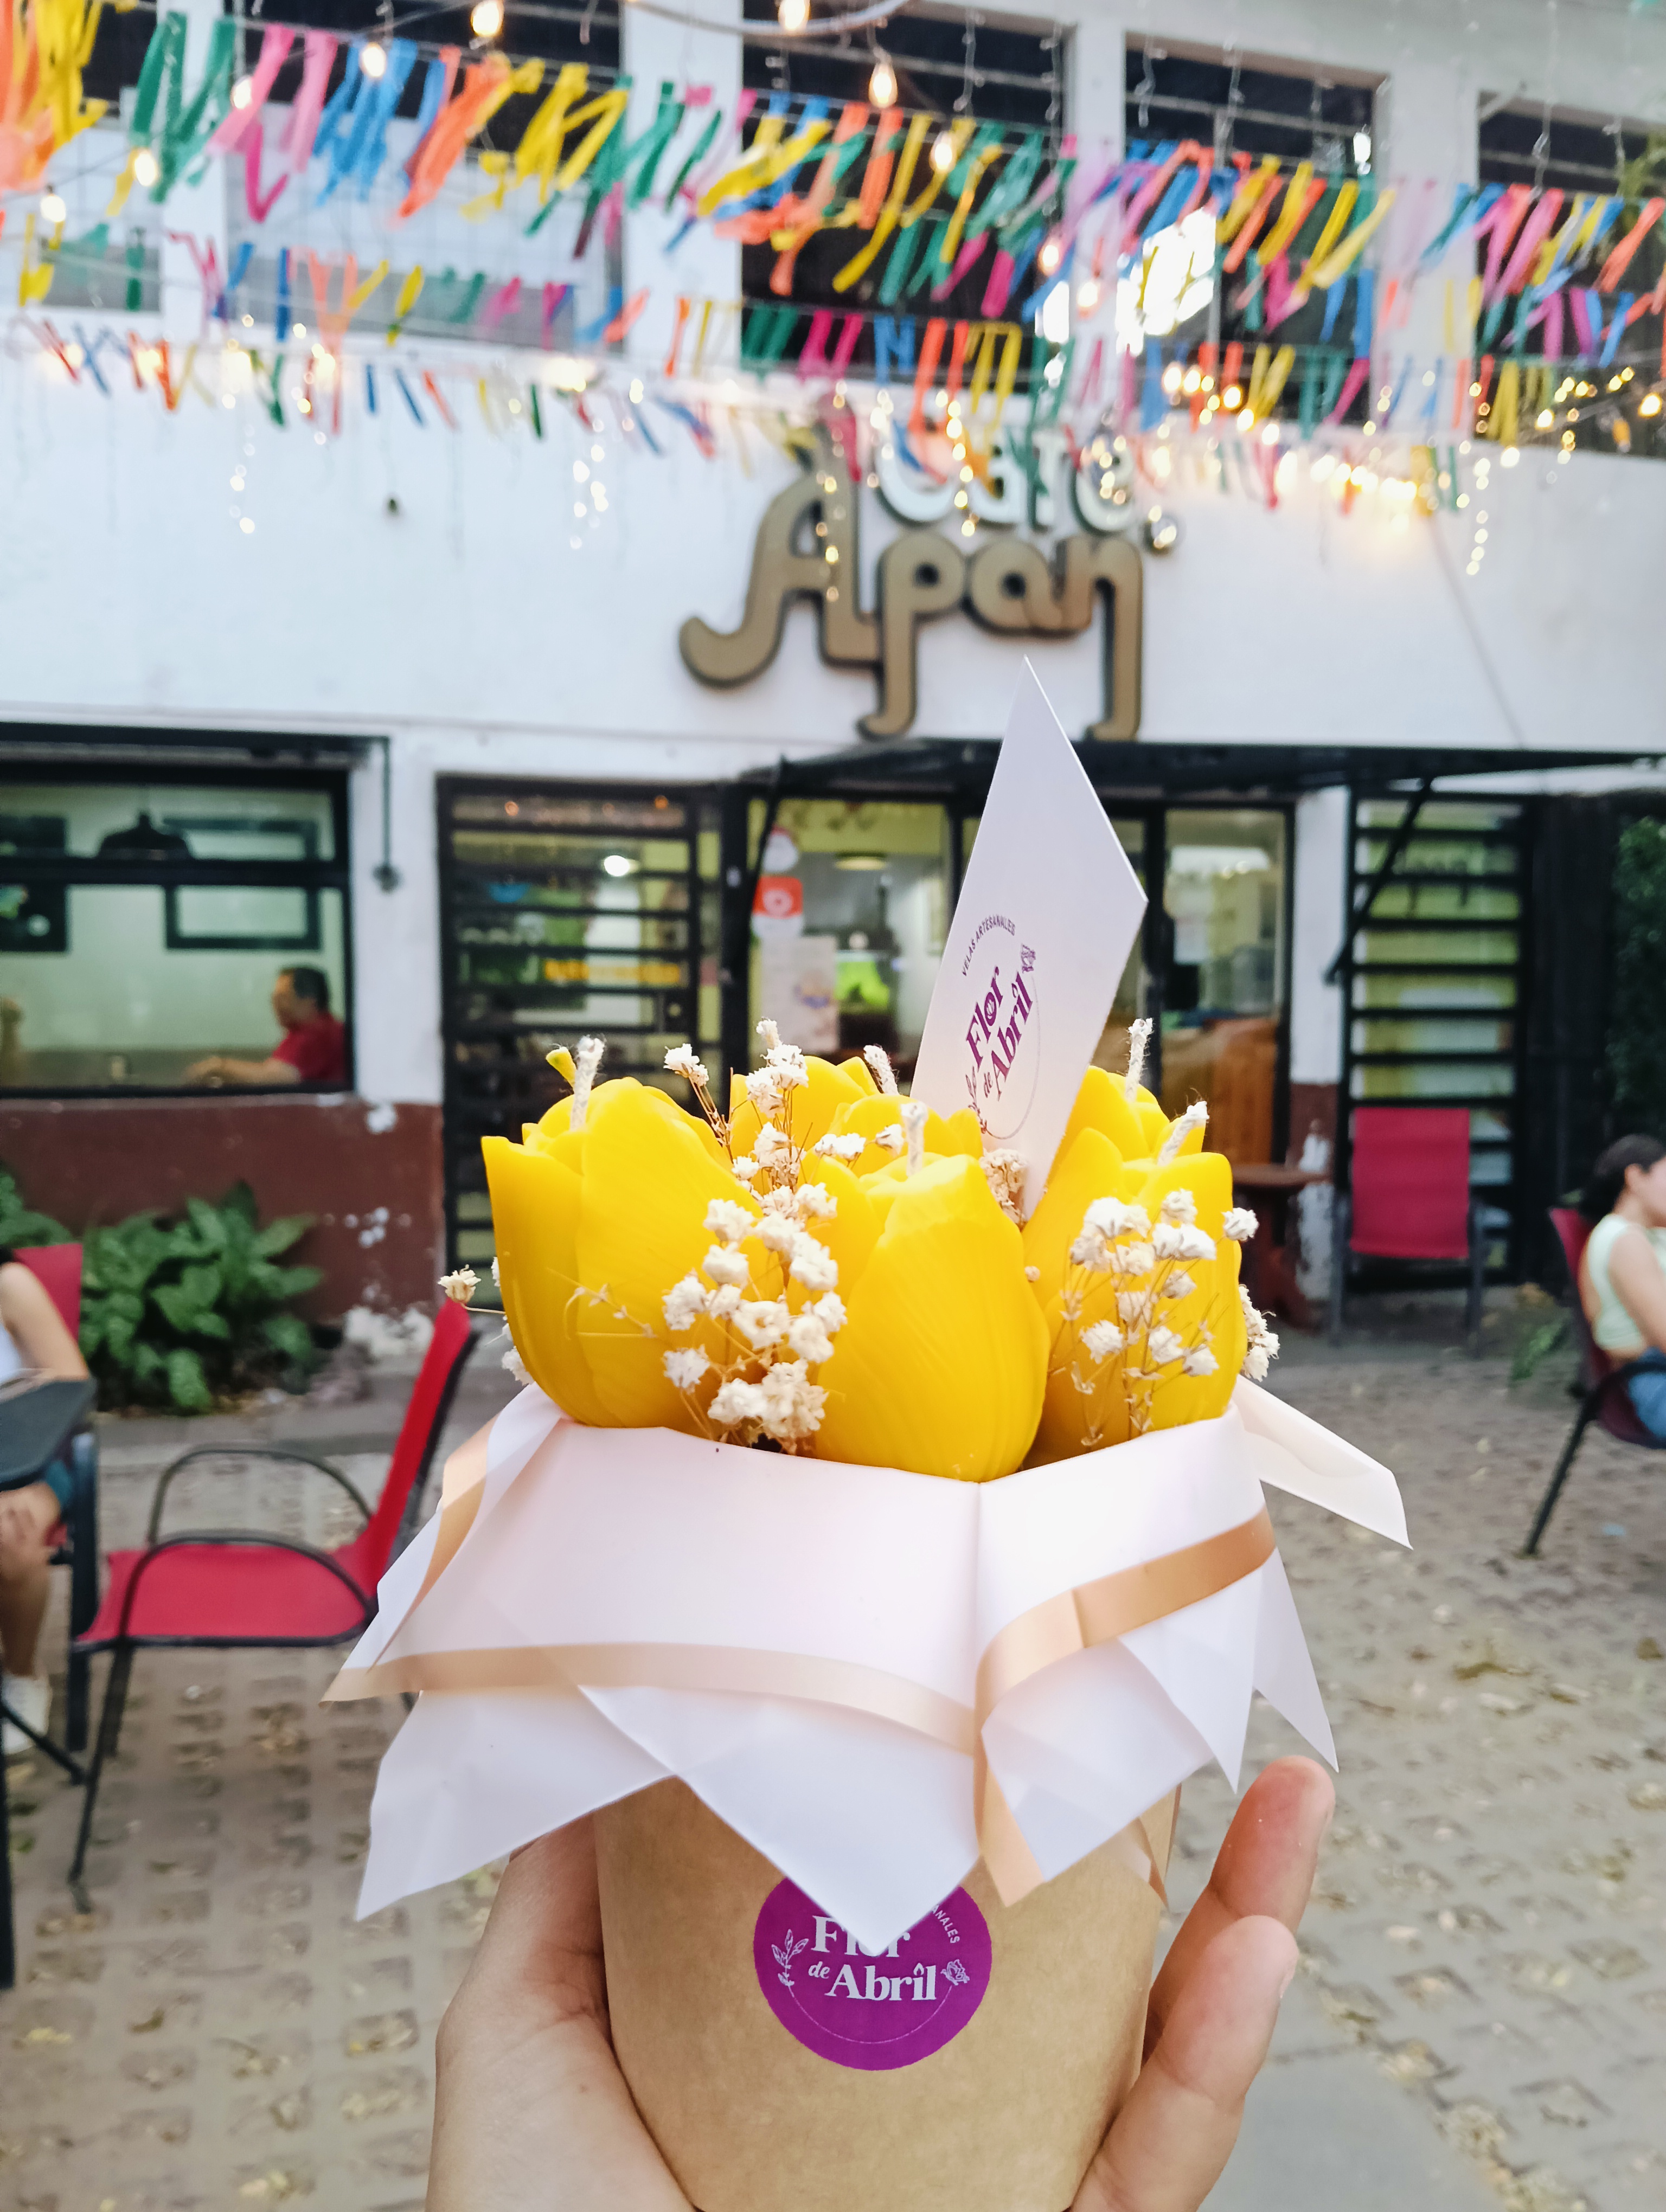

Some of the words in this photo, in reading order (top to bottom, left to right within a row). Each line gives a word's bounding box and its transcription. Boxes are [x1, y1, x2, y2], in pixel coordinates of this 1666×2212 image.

[678, 391, 1144, 743] Apan
[962, 938, 976, 976] VELAS
[975, 914, 1016, 943] ARTESANALES
[965, 966, 1003, 1073] Flor
[983, 1071, 994, 1098] de
[930, 1903, 960, 1944] ANALES
[808, 1960, 831, 1979] de
